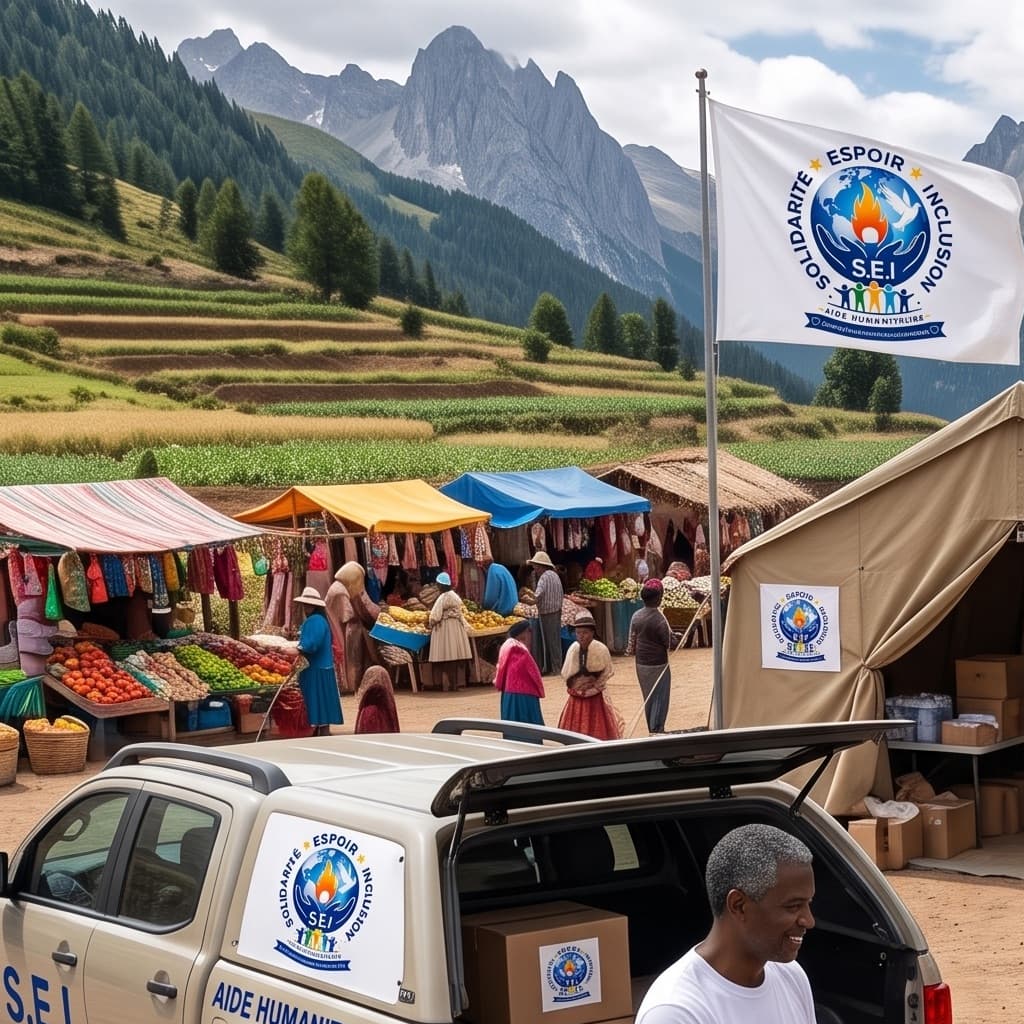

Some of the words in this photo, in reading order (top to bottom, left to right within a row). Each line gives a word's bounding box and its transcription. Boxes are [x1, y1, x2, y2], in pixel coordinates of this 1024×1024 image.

[826, 146, 905, 172] ESPOIR
[920, 184, 953, 293] INCLUSION
[851, 258, 896, 280] S.E.I
[312, 833, 358, 856] ESPOIR
[308, 911, 332, 929] SEI
[212, 982, 255, 1019] AIDE
